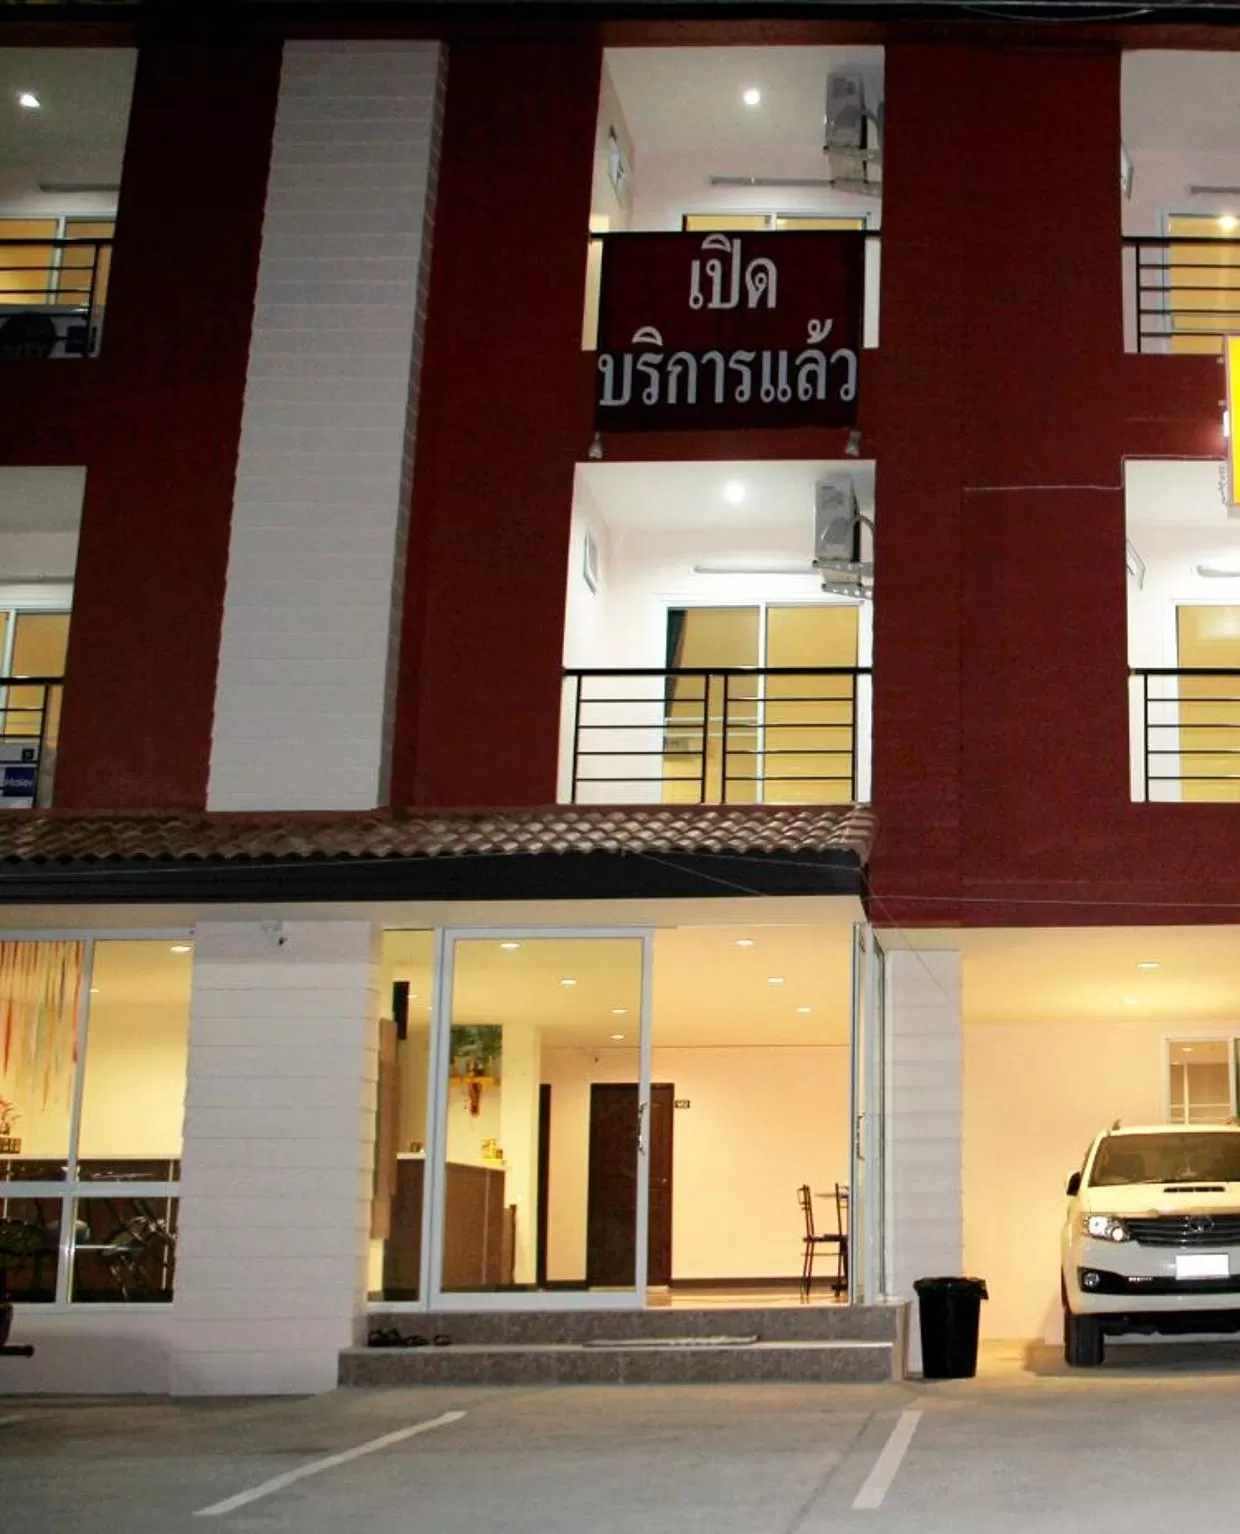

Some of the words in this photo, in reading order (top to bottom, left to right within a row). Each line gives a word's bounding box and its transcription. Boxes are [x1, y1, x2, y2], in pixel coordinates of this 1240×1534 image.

[688, 232, 778, 310] เปิด
[598, 318, 858, 406] บริการแล้ว
